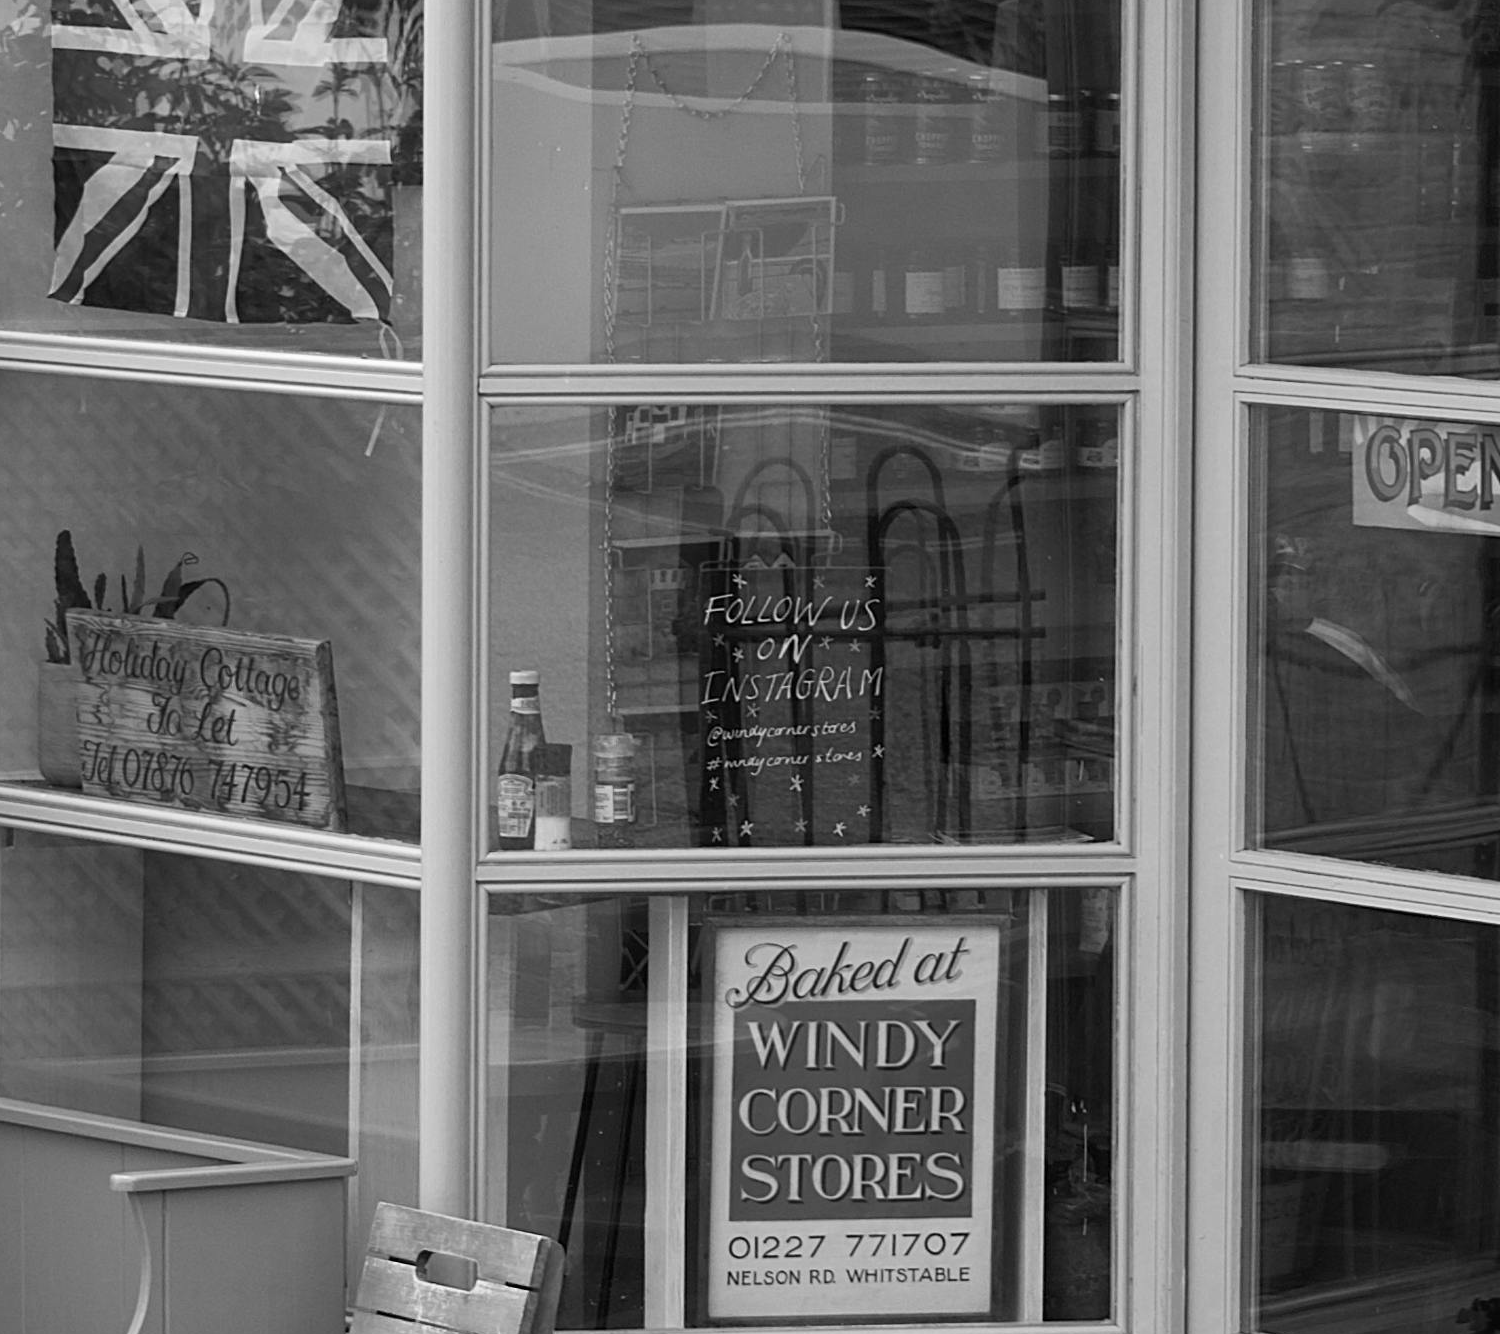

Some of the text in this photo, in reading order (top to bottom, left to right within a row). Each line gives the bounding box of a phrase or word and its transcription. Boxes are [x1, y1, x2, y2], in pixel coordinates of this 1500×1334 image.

[703, 593, 881, 632] FOLLOW US
[84, 631, 300, 712] Holiday Cottage
[756, 633, 813, 665] ON
[700, 665, 884, 705] INSTAGRAM
[146, 692, 239, 747] To Let
[208, 758, 311, 812] 747954
[725, 935, 971, 1009] Baked at
[747, 1018, 962, 1071] WINDY
[738, 1086, 967, 1137] CORNER
[740, 1151, 966, 1204] STORES
[728, 1232, 971, 1260] 01227 771707
[726, 1269, 801, 1287] NELSON
[846, 1266, 971, 1285] WHITSTABLE
